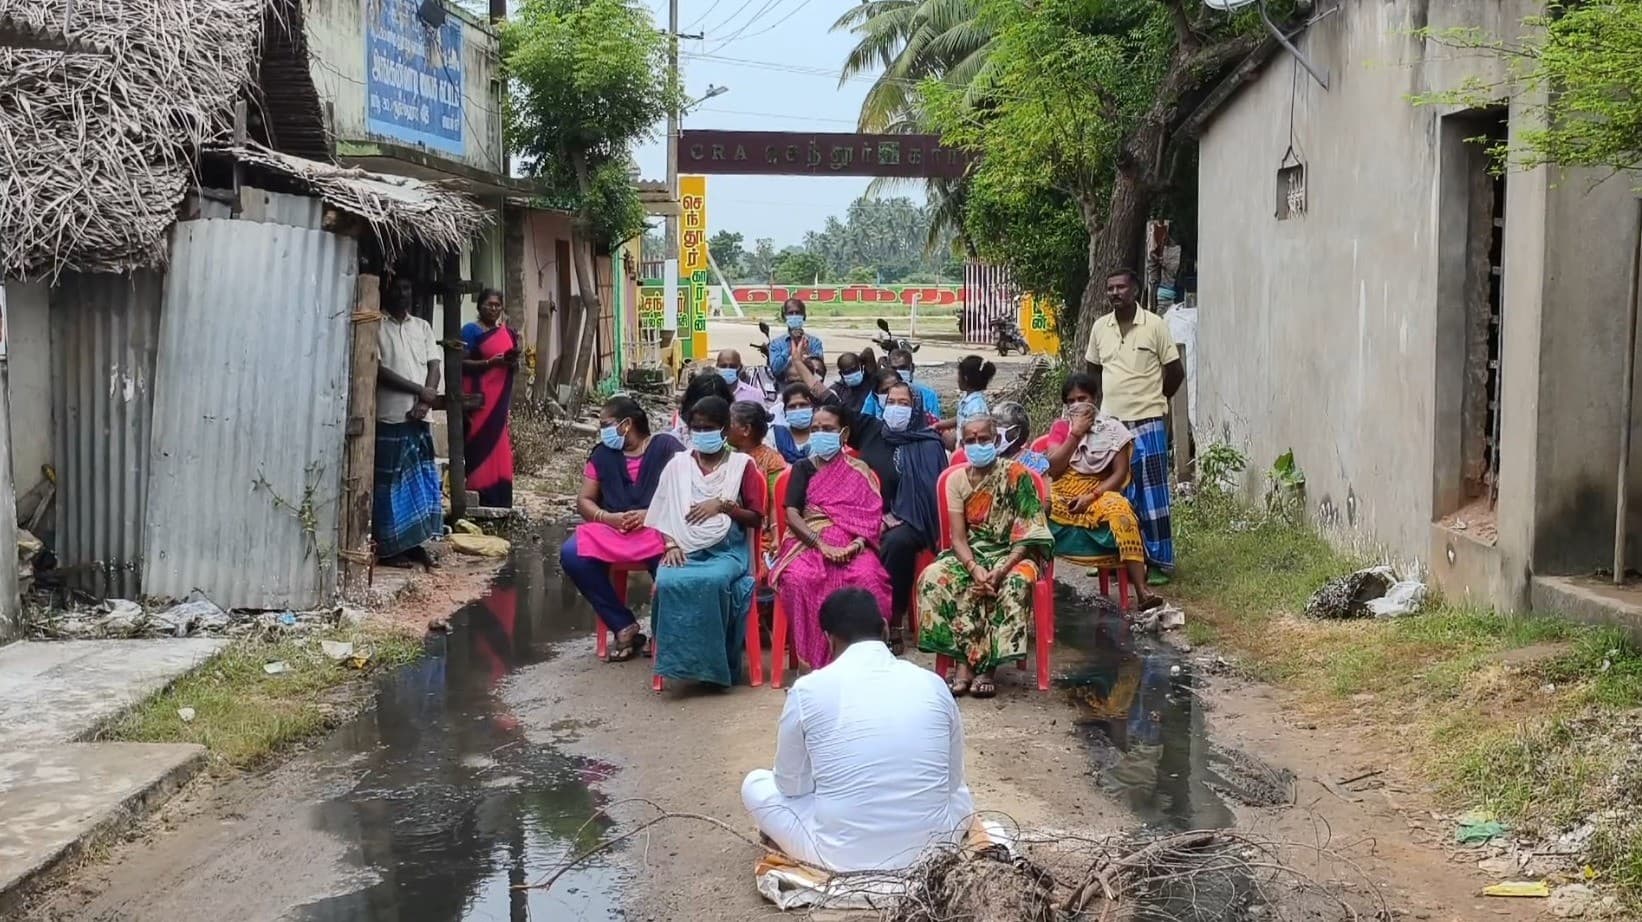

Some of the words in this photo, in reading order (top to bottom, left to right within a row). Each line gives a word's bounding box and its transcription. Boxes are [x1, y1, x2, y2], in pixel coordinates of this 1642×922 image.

[690, 143, 748, 161] CRA
[682, 195, 704, 267] செந்தூர்
[691, 270, 707, 332] கார்டன்
